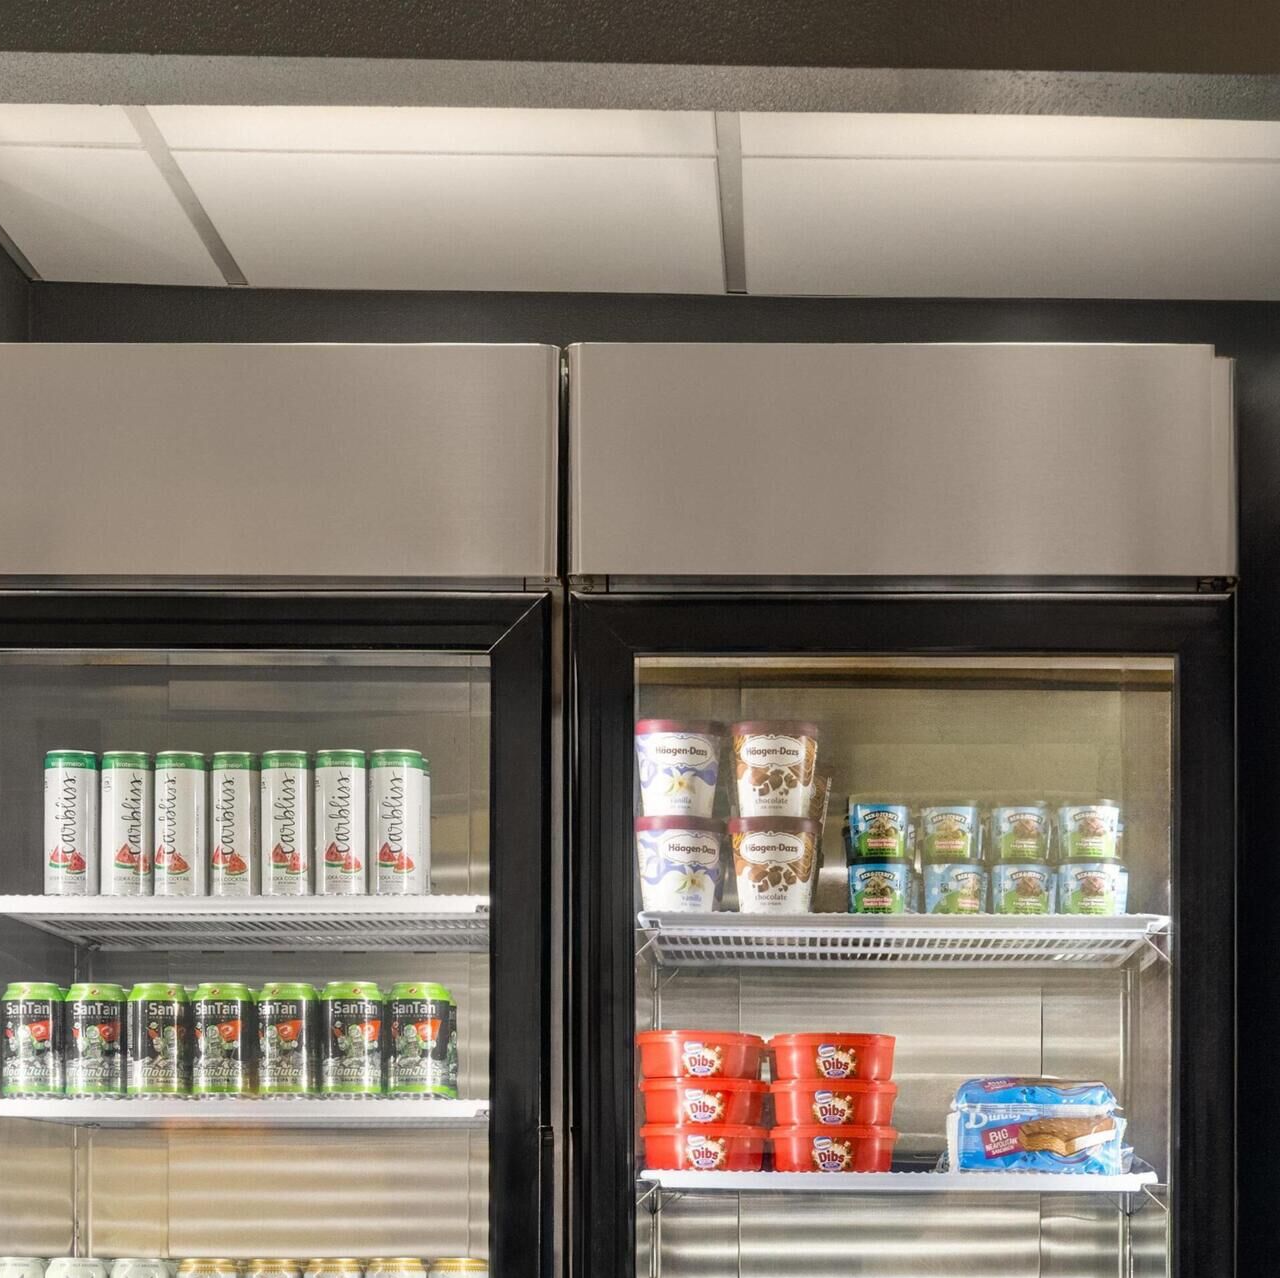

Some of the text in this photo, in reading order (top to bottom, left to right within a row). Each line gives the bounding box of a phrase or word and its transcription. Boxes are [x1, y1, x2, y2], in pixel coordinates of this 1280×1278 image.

[746, 745, 799, 757] Häagen-Dazs
[755, 797, 789, 805] chocolate
[745, 843, 798, 854] Häagen-Dazs
[755, 893, 788, 901] chocolate
[6, 1001, 50, 1016] SanTan
[73, 1001, 118, 1016] SanTan
[195, 1001, 239, 1016] SanTan
[334, 1000, 378, 1015] SanTan
[392, 1000, 436, 1015] SanTan
[689, 1054, 715, 1068] Dibs
[823, 1057, 849, 1071] Dibs
[690, 1101, 716, 1114] Dibs
[820, 1104, 846, 1117] Dibs
[989, 1128, 1009, 1140] BIG
[692, 1147, 719, 1160] Dibs
[820, 1150, 845, 1163] Dibs
